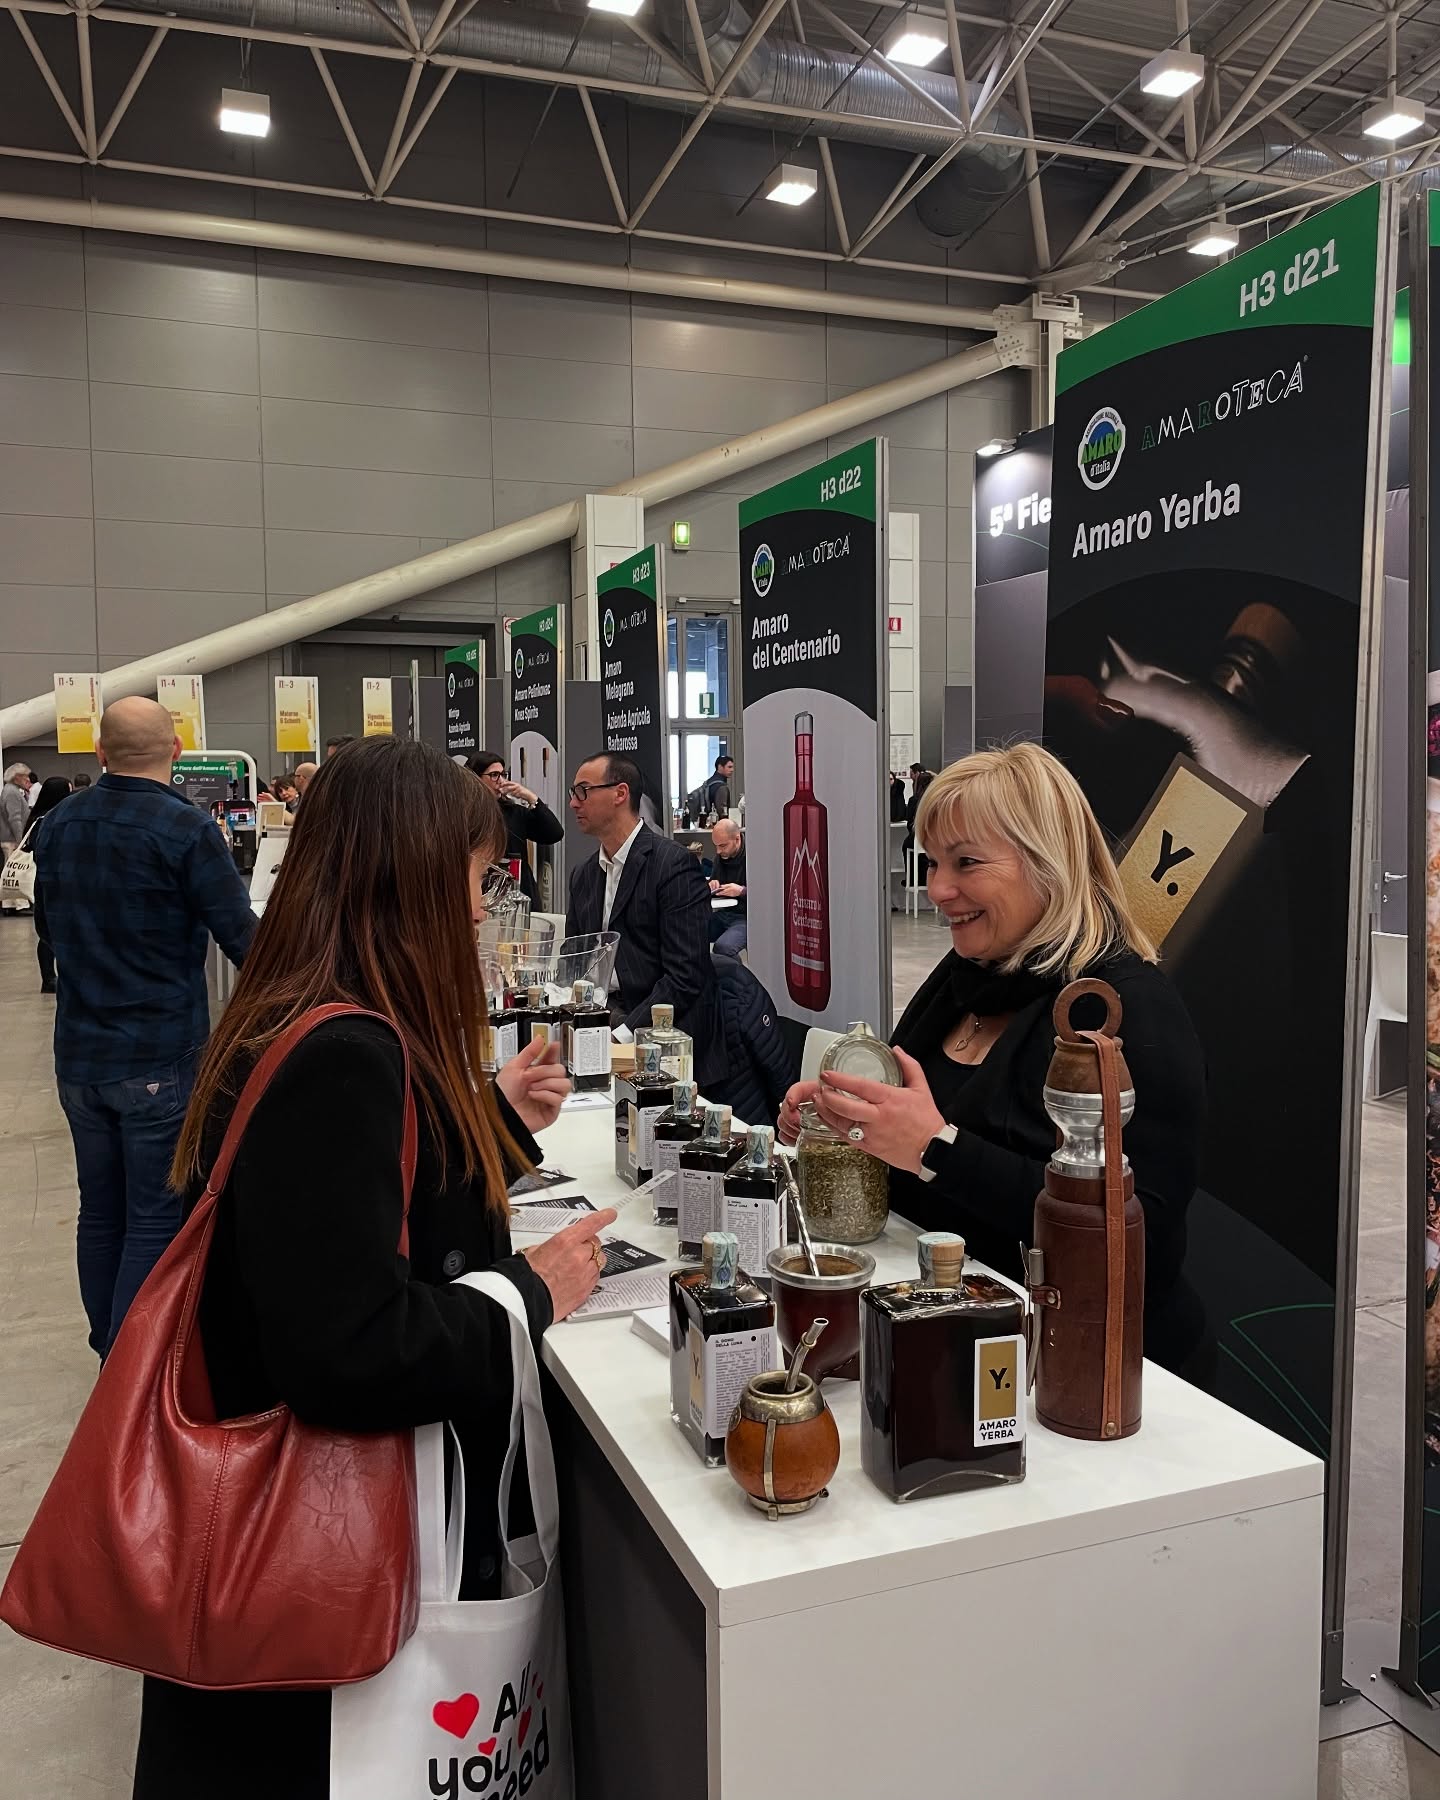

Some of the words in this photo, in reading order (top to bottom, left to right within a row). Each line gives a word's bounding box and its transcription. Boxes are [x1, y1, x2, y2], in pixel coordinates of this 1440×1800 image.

[1239, 270, 1276, 317] H3
[1283, 238, 1339, 297] d21
[1081, 429, 1122, 464] AMARO
[820, 477, 836, 503] H3
[839, 465, 862, 494] d22
[1072, 510, 1153, 558] Amaro
[1159, 479, 1240, 533] Yerba
[632, 568, 640, 584] H3
[640, 561, 651, 581] d23
[752, 613, 789, 640] Amaro
[752, 643, 769, 670] del
[772, 628, 840, 664] Centenario
[605, 660, 622, 678] Amaro
[69, 678, 74, 686] 5
[171, 679, 176, 688] 4
[376, 682, 380, 690] 2
[605, 680, 634, 701] Melagrana
[515, 689, 528, 701] Amaro
[607, 709, 627, 730] Azienda
[627, 705, 651, 731] Agricola
[607, 734, 638, 751] Barbarossa
[7, 870, 16, 878] LA
[1150, 829, 1195, 896] Y.
[989, 1367, 1011, 1390] Y.
[979, 1419, 1017, 1431] AMARO
[981, 1430, 1014, 1441] YERBA
[493, 1661, 531, 1733] All
[429, 1737, 512, 1800] you
